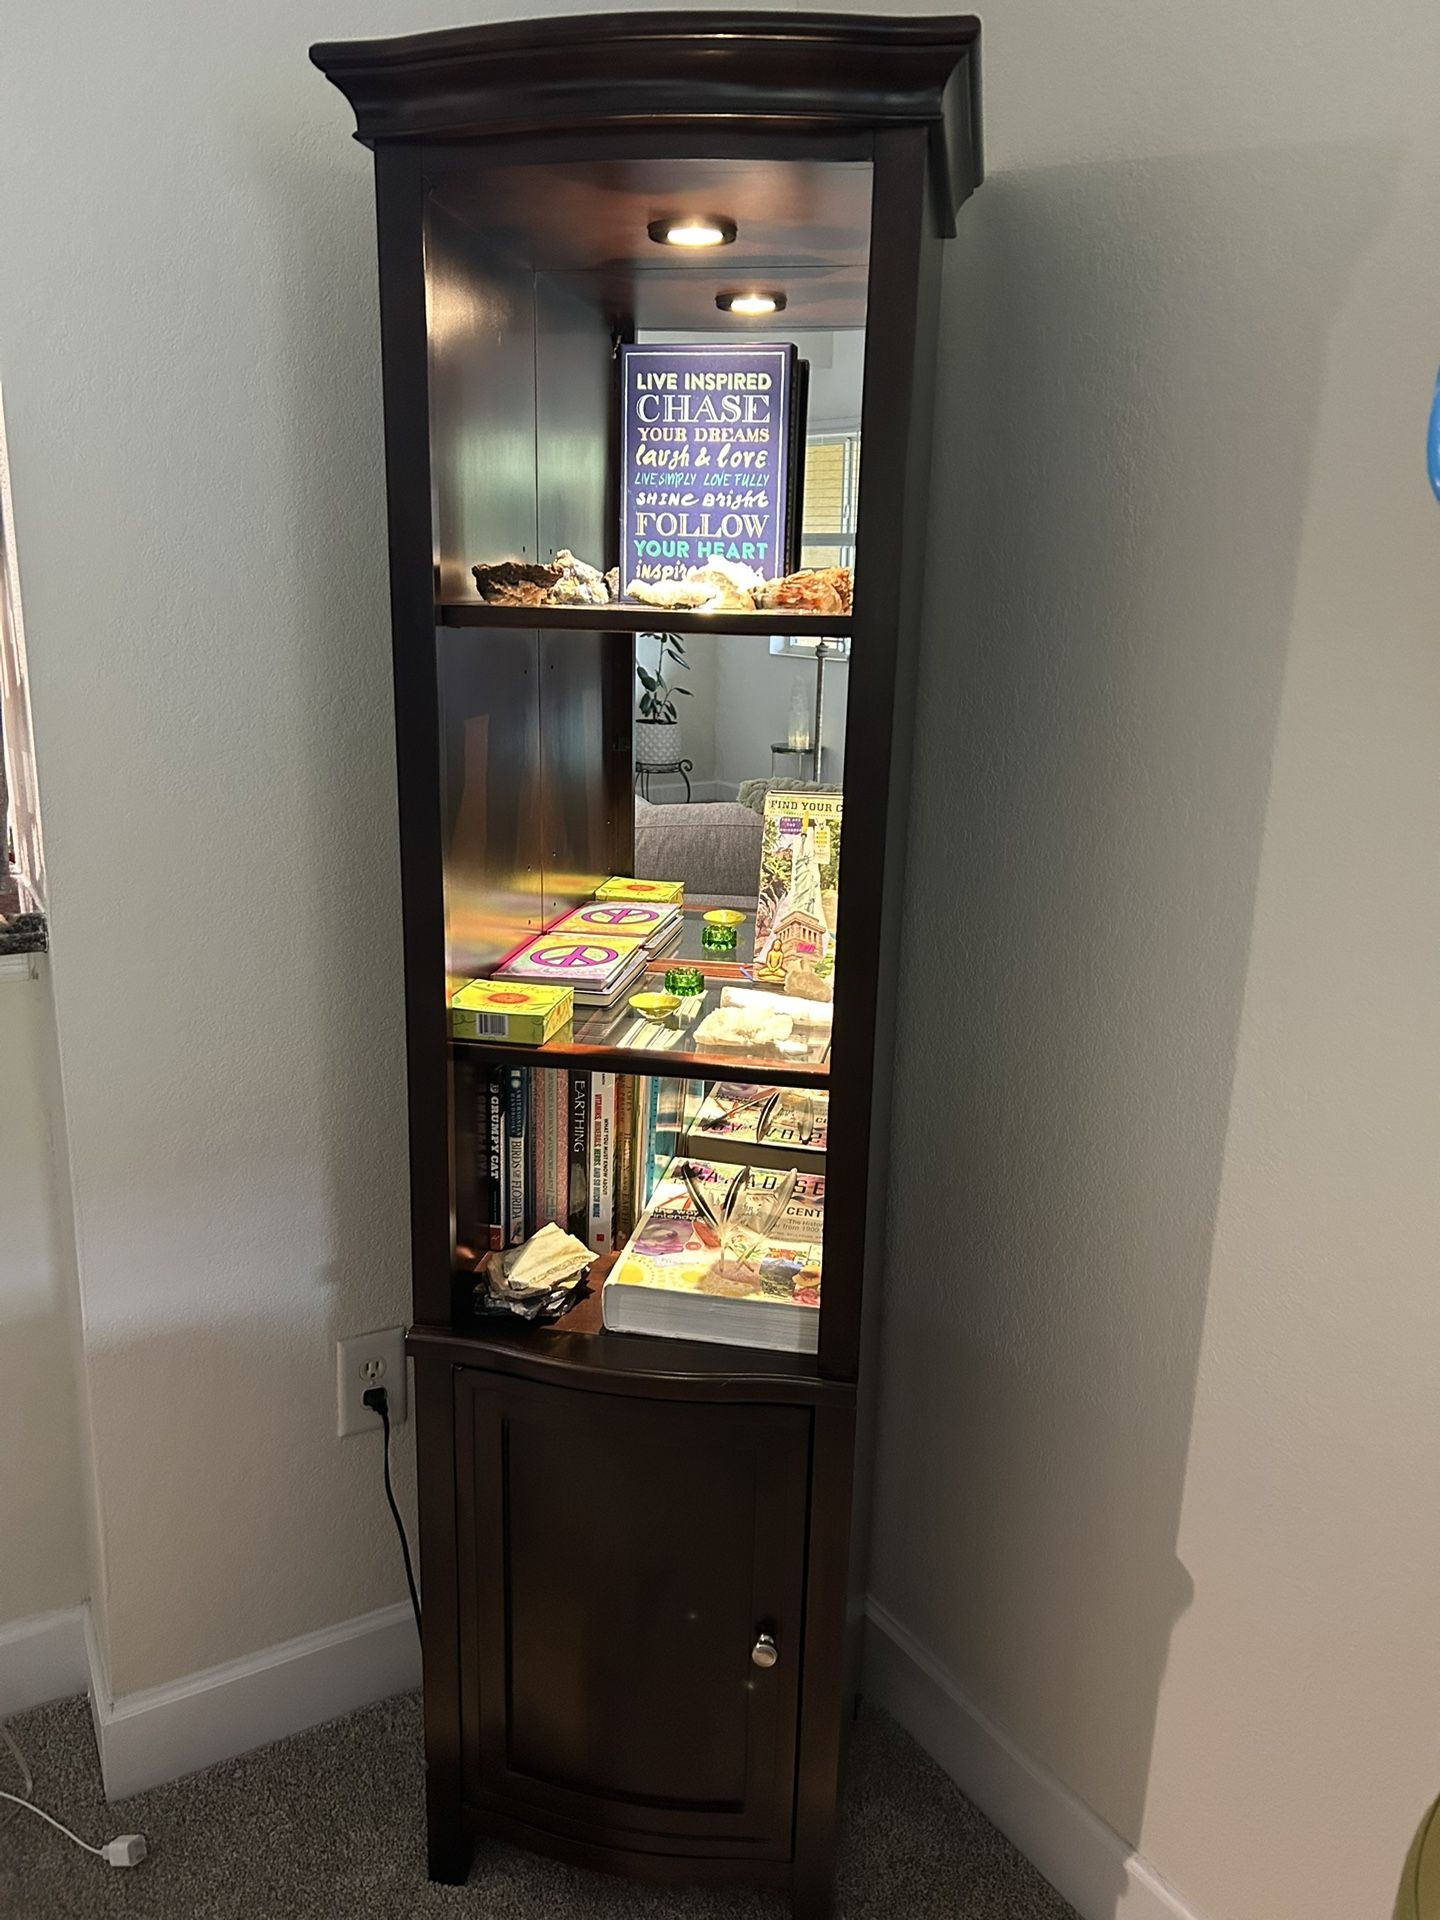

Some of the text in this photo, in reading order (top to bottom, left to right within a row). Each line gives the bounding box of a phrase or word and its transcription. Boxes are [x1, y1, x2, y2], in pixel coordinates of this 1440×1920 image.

[636, 373, 772, 391] LIVE INSPIRED
[636, 394, 770, 423] CHASE
[637, 427, 770, 443] YOUR DREAMS
[635, 444, 768, 470] laugh & love
[634, 470, 770, 488] LIVE SIMPLY LOVE FULLY
[635, 512, 770, 538] FOLLOW
[634, 540, 768, 560] YOUR HEART
[771, 800, 798, 810] FIND
[801, 801, 832, 812] YOUR
[490, 1096, 500, 1153] GRUMPY
[573, 1080, 586, 1152] EARTHING
[490, 1154, 500, 1179] CAT
[511, 1140, 522, 1169] BIRDS
[511, 1180, 522, 1219] FLORIDA
[621, 1193, 631, 1225] EARTH
[677, 1208, 699, 1216] way
[786, 1206, 823, 1218] CENT
